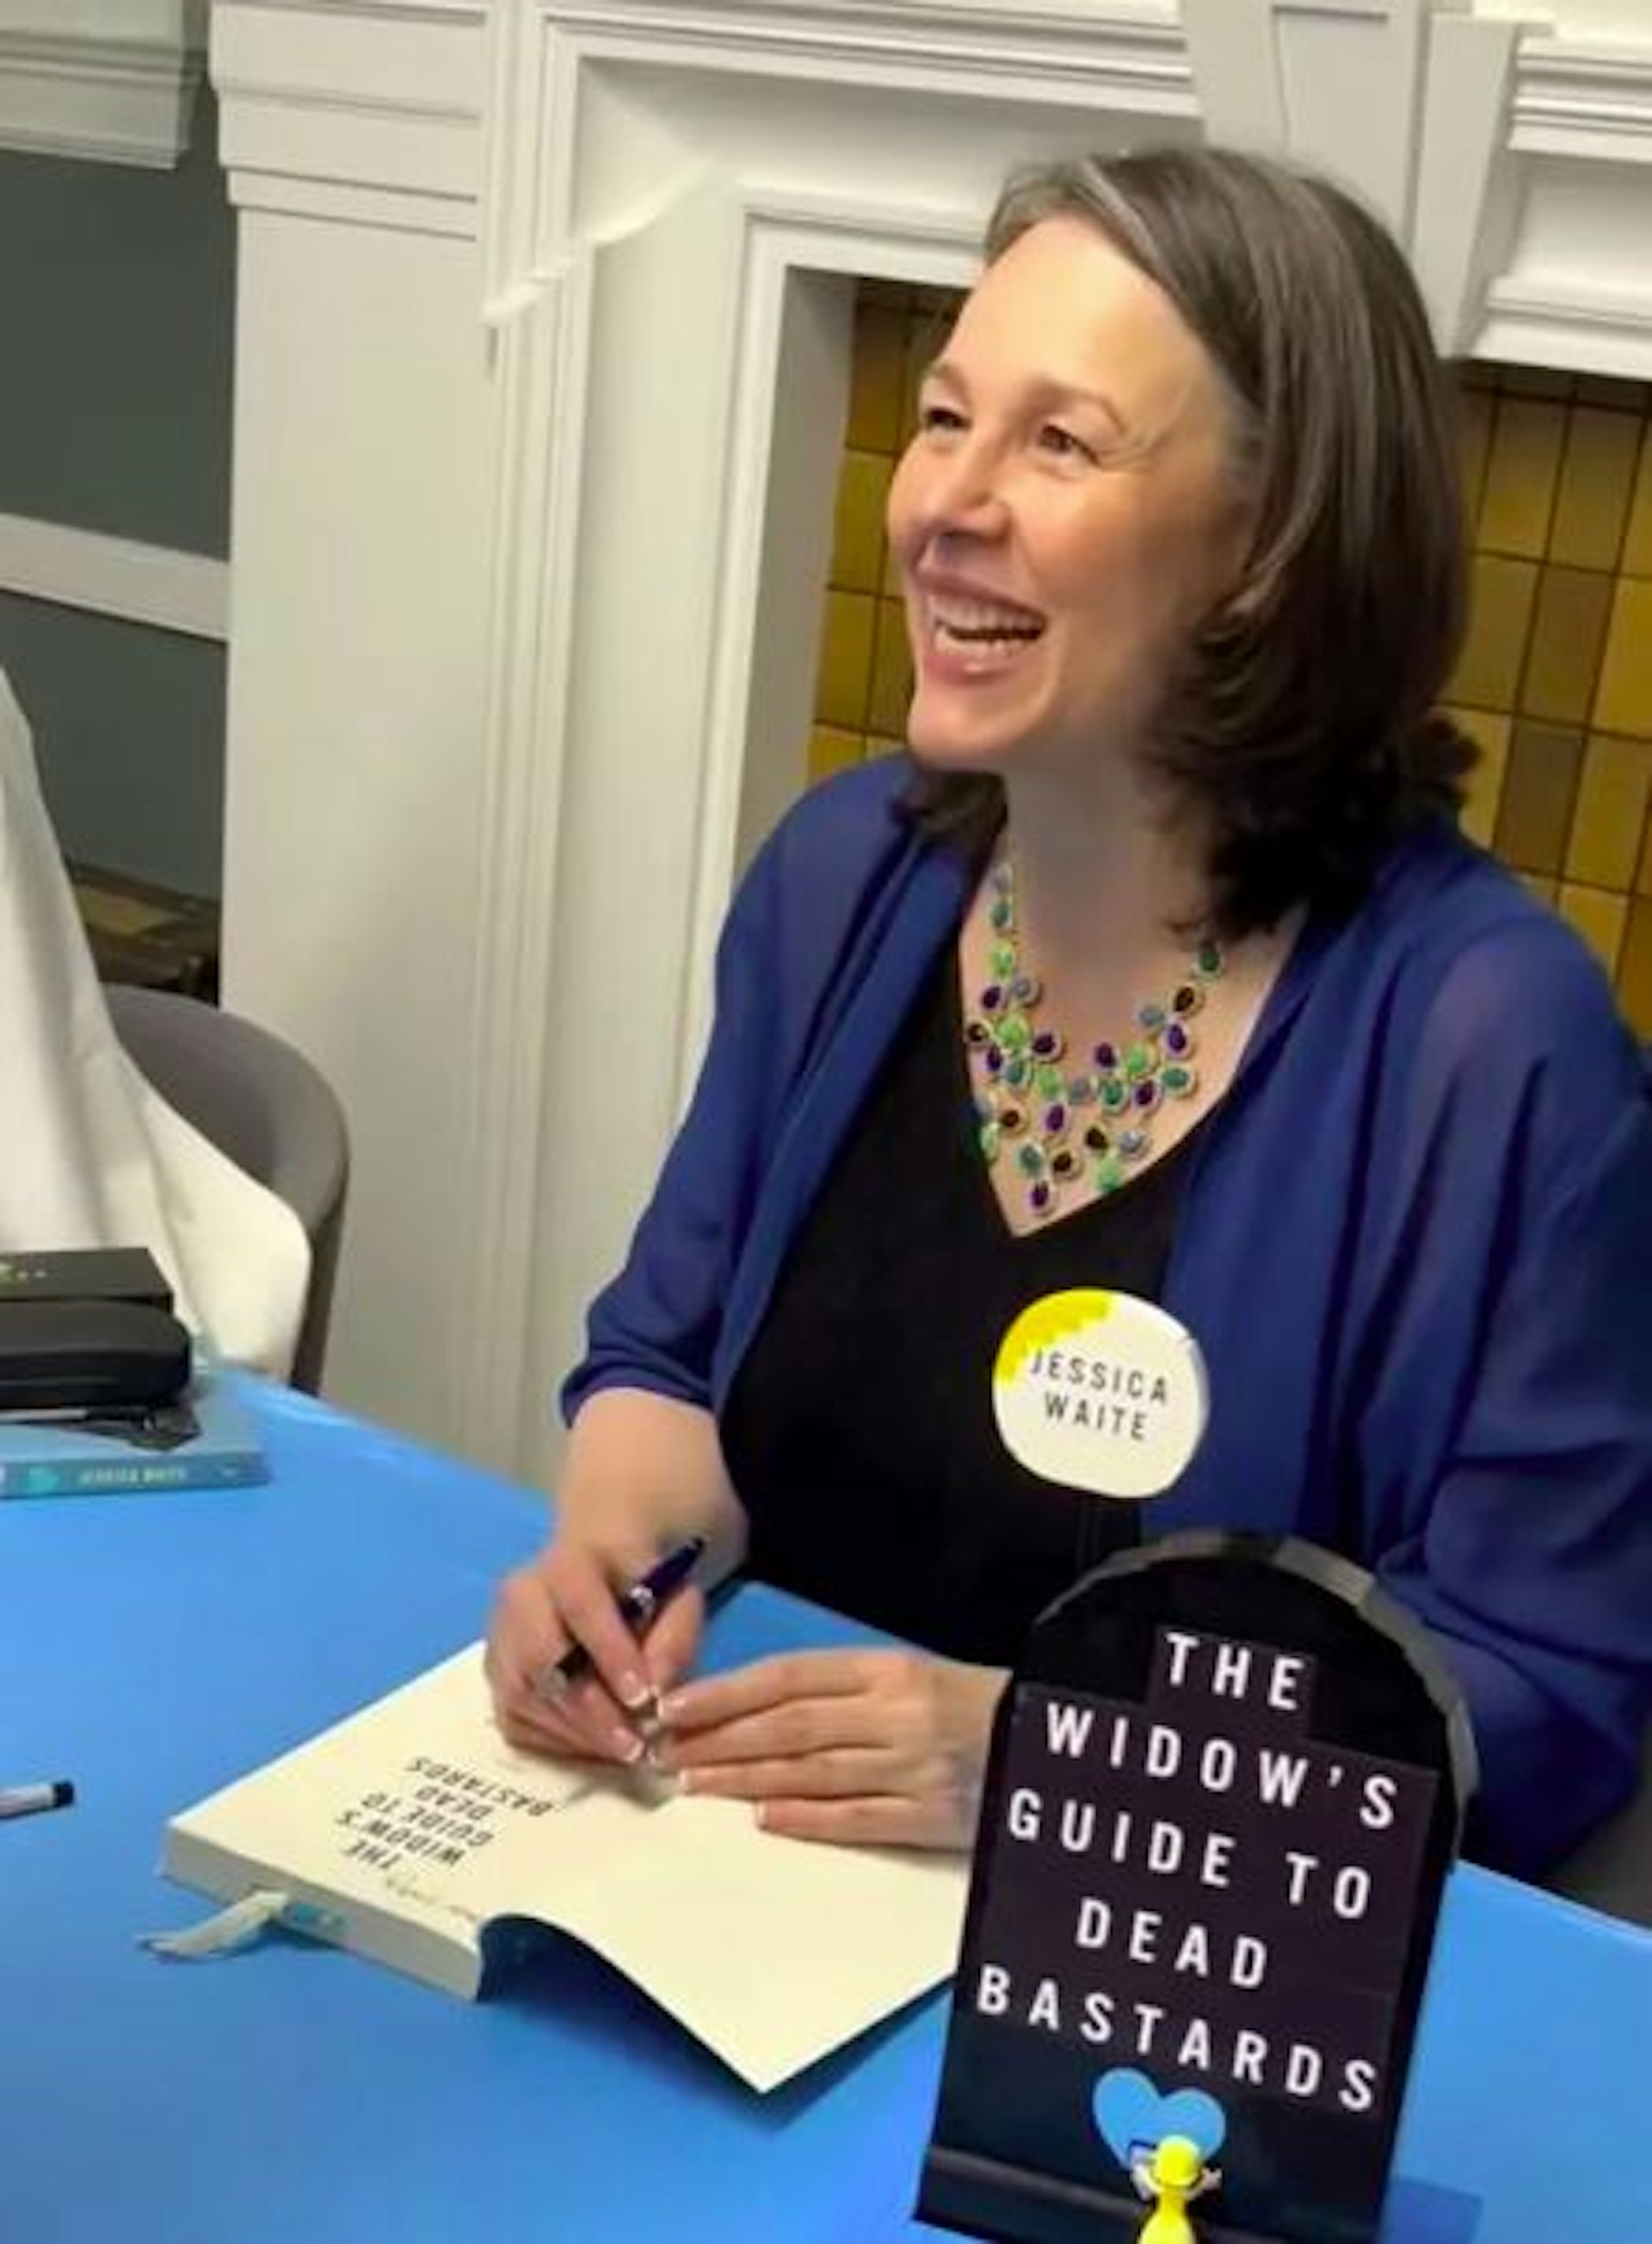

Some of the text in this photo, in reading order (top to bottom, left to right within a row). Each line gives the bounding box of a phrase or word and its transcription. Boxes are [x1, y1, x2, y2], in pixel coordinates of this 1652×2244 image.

[1031, 1349, 1168, 1405] JESSICA
[1045, 1390, 1147, 1440] WAITE
[1165, 1632, 1308, 1710] THE
[405, 1757, 553, 1816] BASTARDS
[1046, 1702, 1397, 1830] WIDOW'S
[361, 1792, 494, 1846] GUIDE TO
[416, 1786, 494, 1820] DEAD
[344, 1840, 402, 1870] THE
[1008, 1789, 1371, 1919] GUIDE TO
[1076, 1898, 1267, 1988] DEAD
[977, 1966, 1377, 2111] BASTARDS
